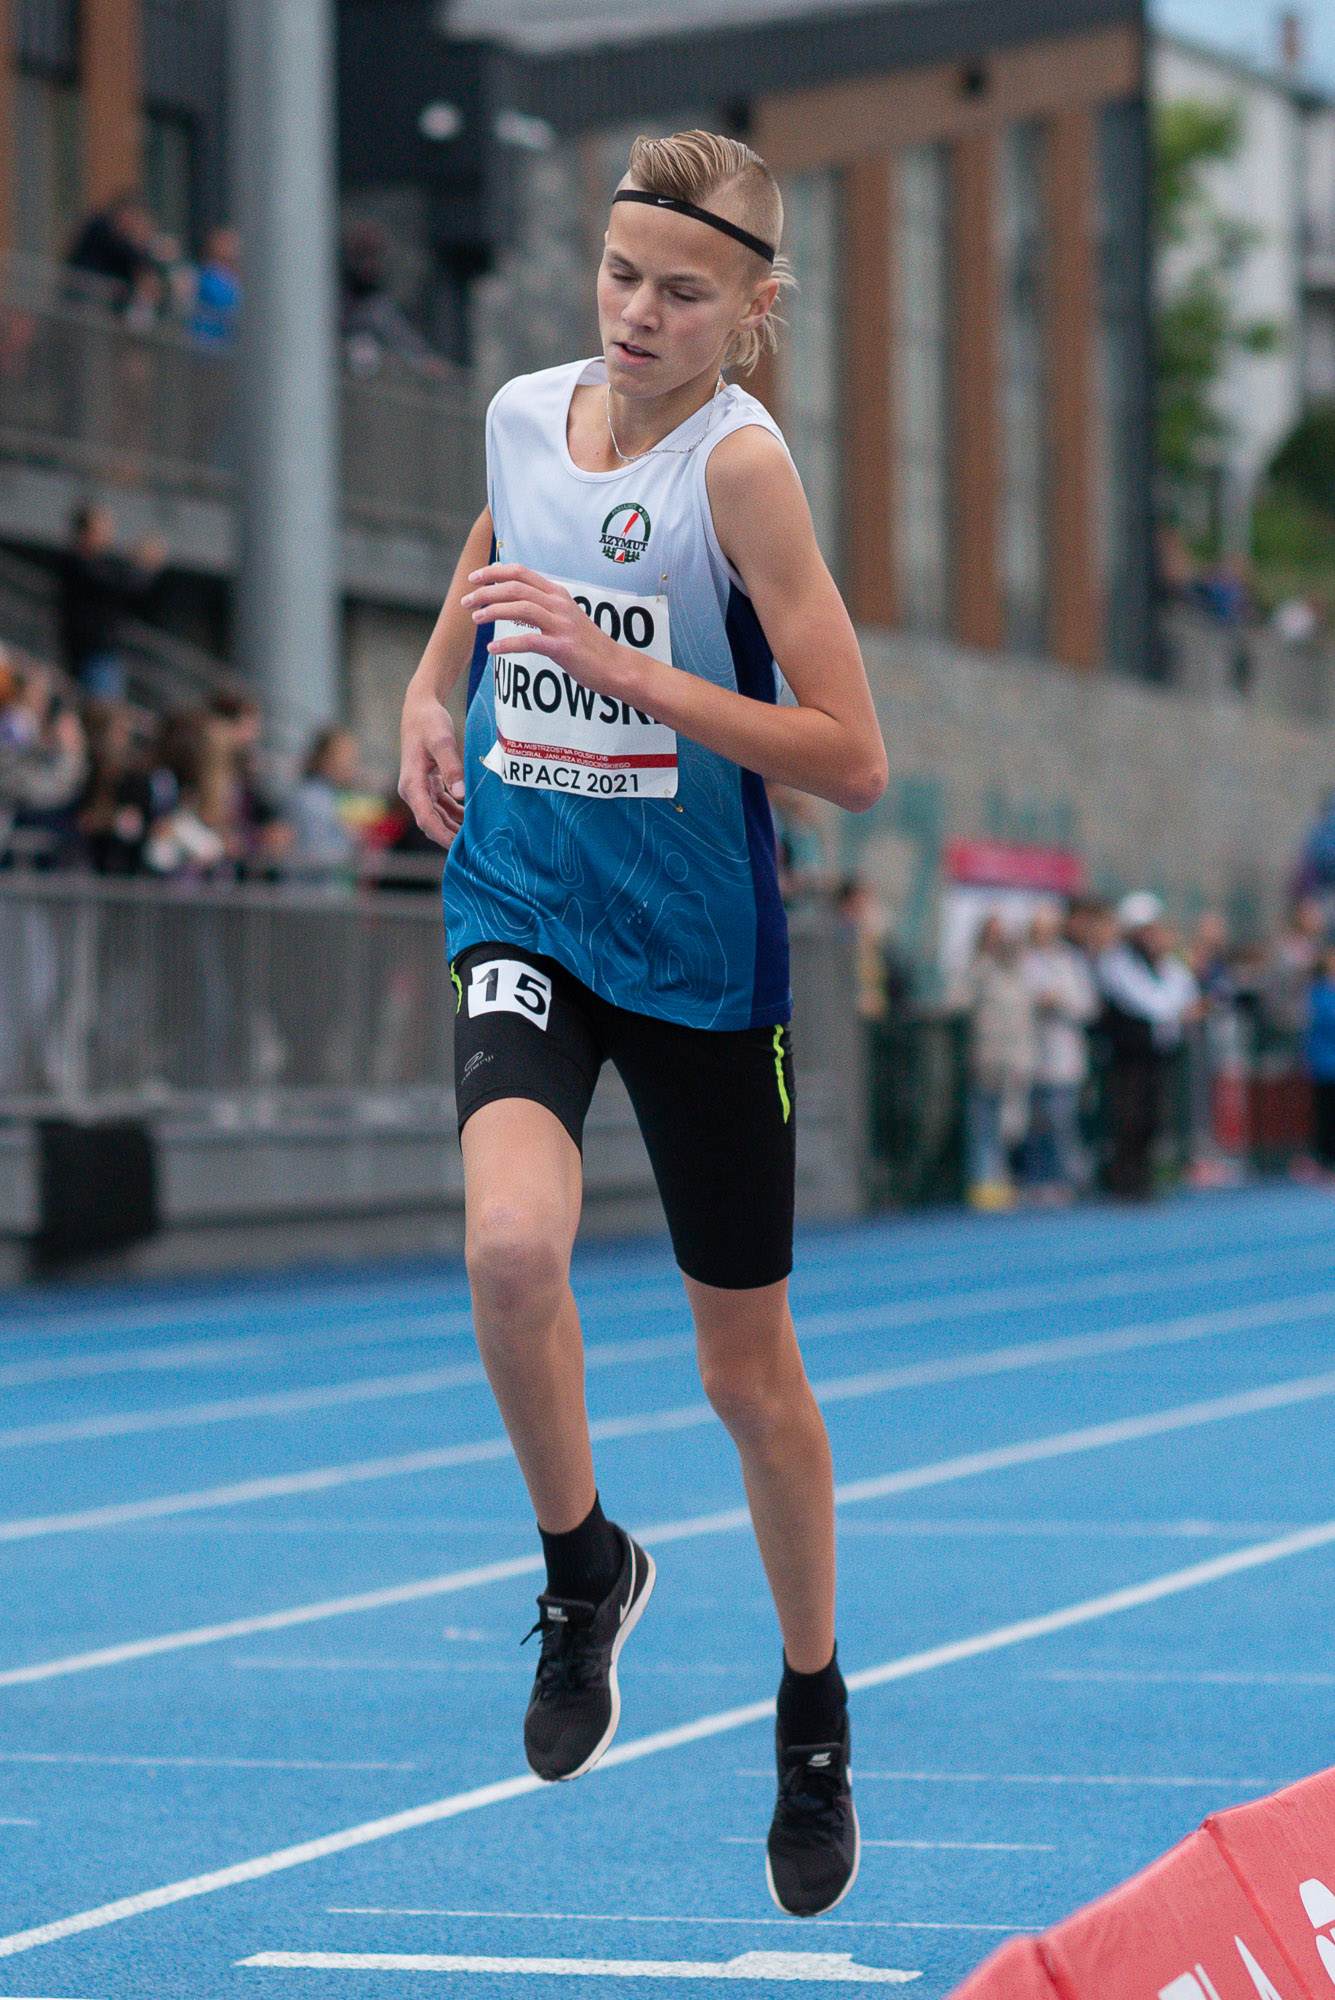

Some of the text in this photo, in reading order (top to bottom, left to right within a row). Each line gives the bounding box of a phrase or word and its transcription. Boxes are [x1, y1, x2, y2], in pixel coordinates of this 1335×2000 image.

[599, 534, 648, 552] AZYMUT
[495, 656, 663, 725] KUROWS
[523, 743, 573, 755] MISTRZOSTWA
[544, 753, 576, 763] JANUSZA
[587, 773, 639, 794] 2021
[477, 967, 547, 1015] 15
